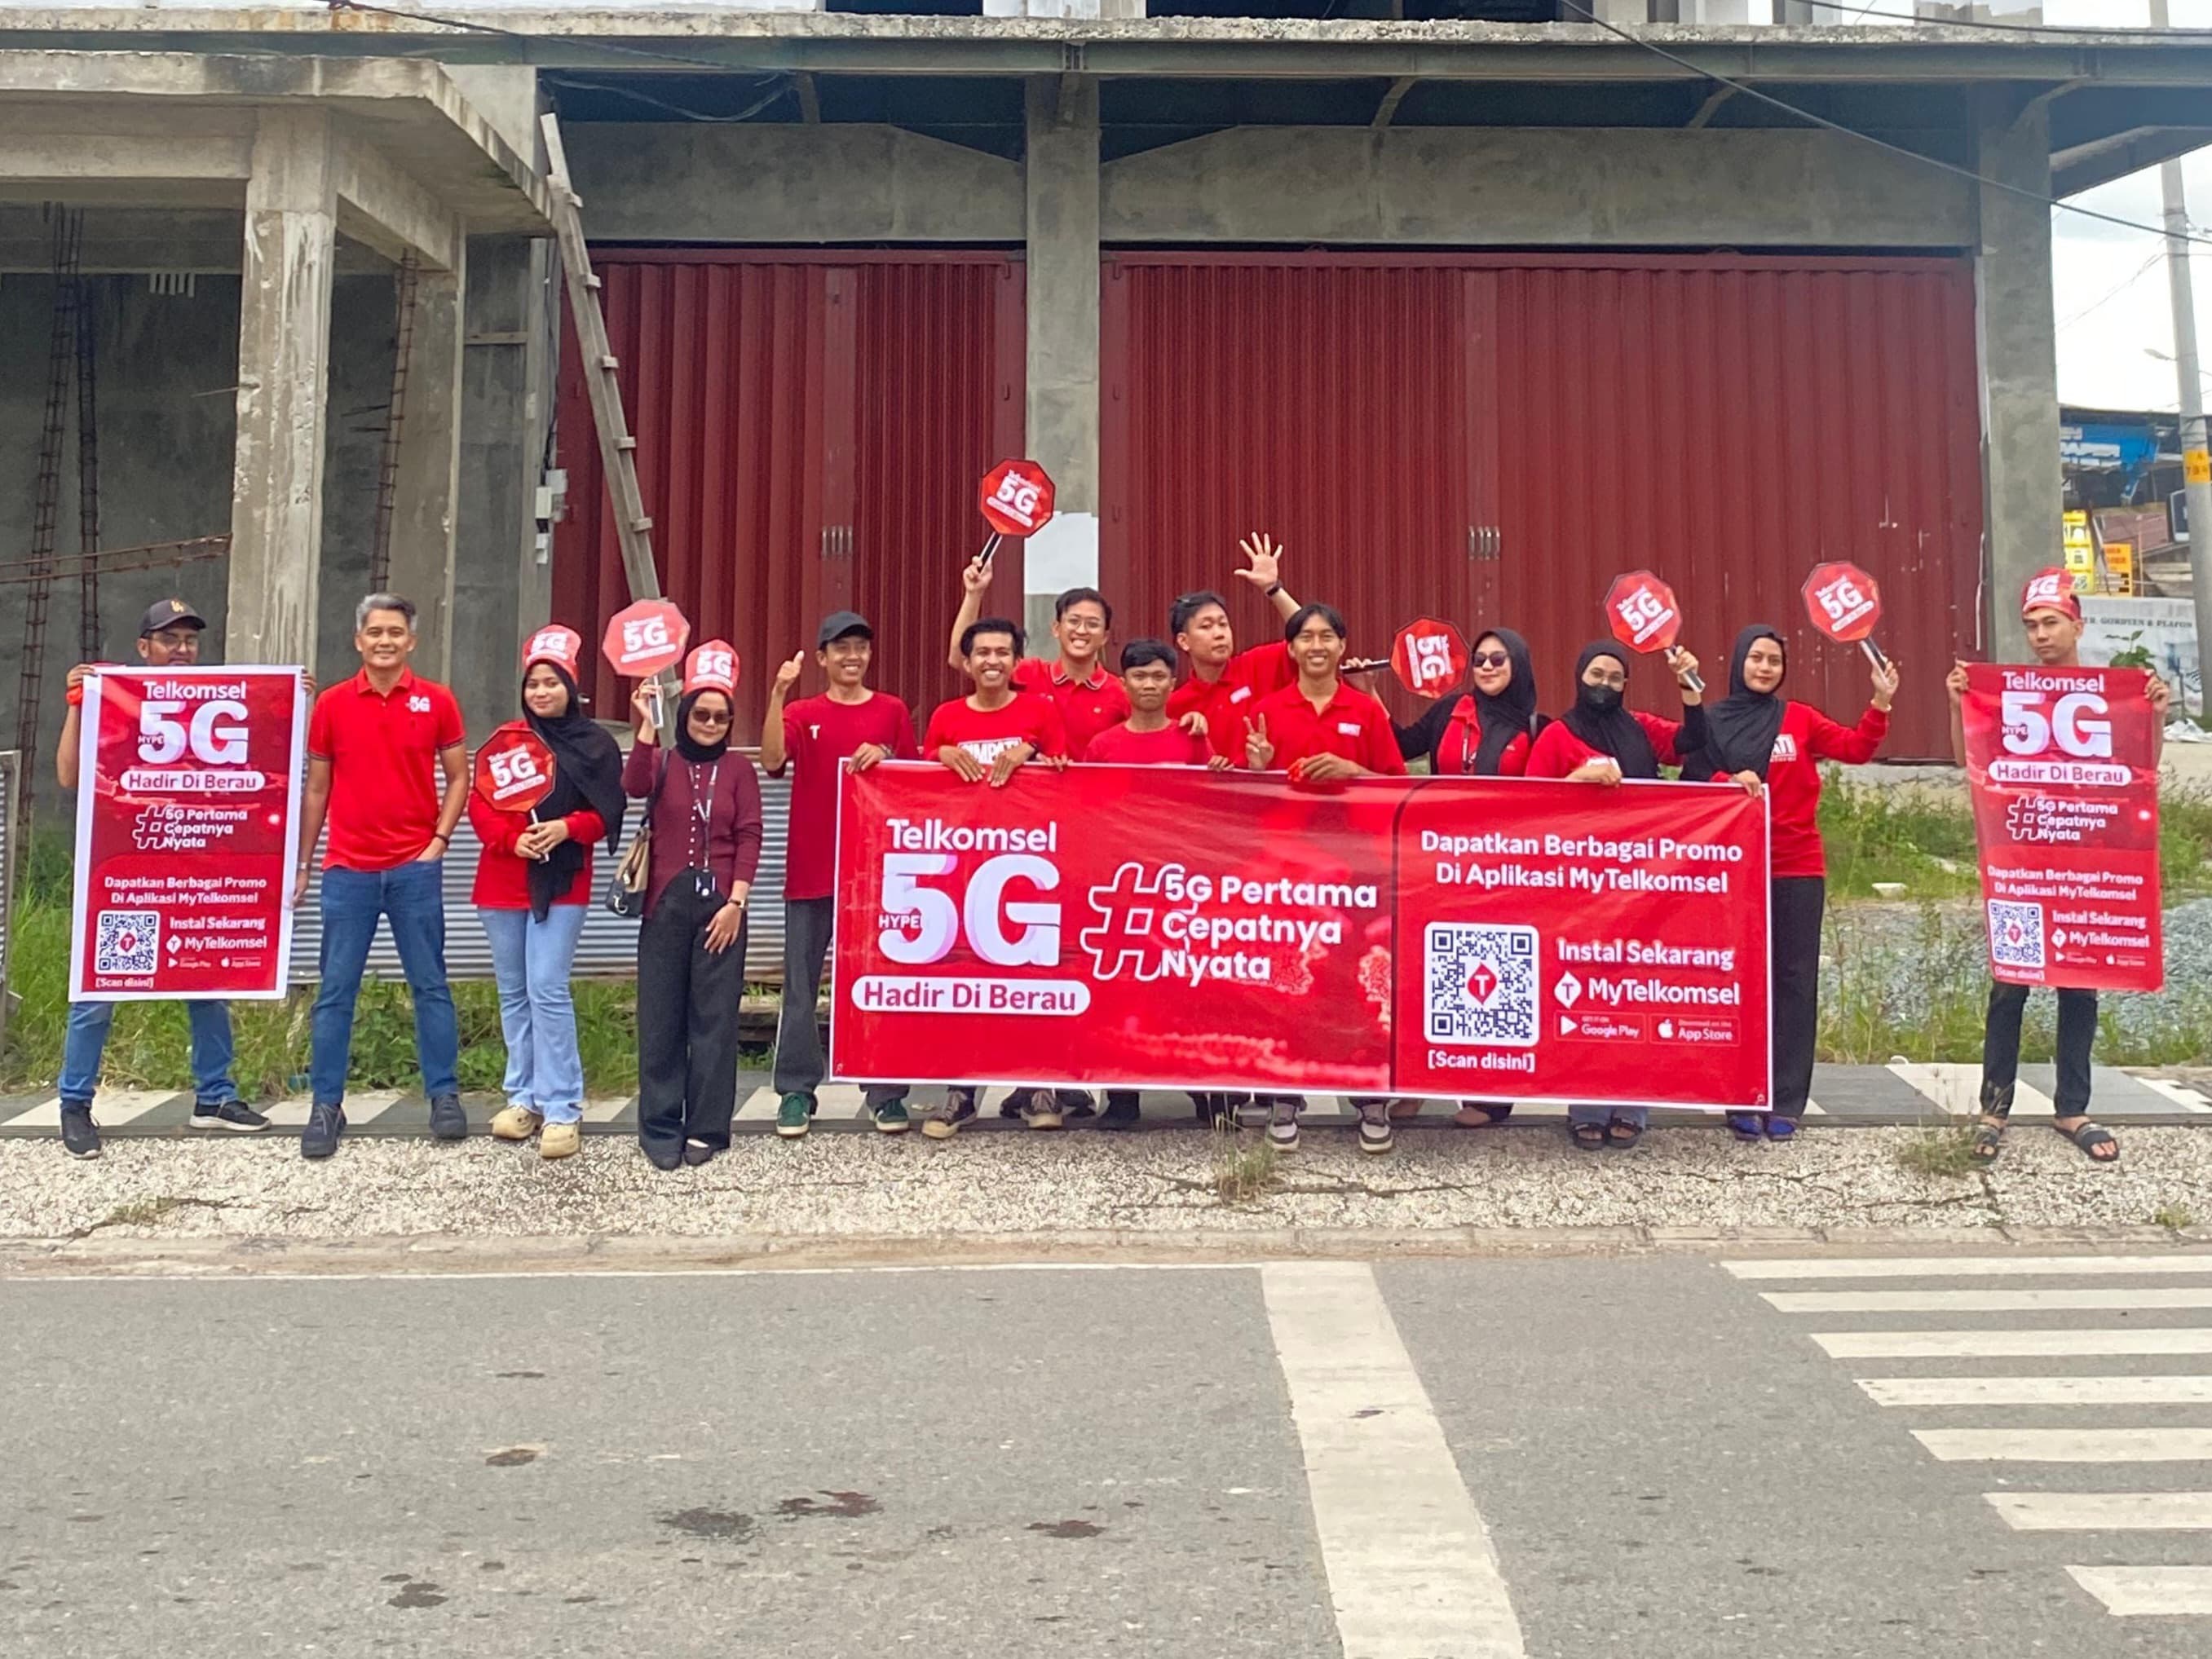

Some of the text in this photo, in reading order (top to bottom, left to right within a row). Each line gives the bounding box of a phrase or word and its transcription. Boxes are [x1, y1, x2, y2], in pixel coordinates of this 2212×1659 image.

[996, 476, 1038, 515] 5G
[1622, 592, 1663, 631] 5G
[1820, 582, 1863, 619] 5G
[623, 622, 667, 652] 5G
[696, 655, 731, 678] 5G
[1417, 636, 1446, 679] 5G
[143, 681, 246, 699] Telkomsel
[2002, 671, 2104, 693] Telkomsel
[409, 695, 430, 713] 5G
[138, 700, 249, 765] 5G
[2001, 691, 2113, 757] 5G
[490, 752, 536, 788] 5G
[1998, 765, 2124, 783] Hadir Di Berau
[129, 774, 256, 789] Hadir Di Berau
[187, 810, 248, 821] Pertama
[2058, 801, 2118, 815] Pertama
[164, 823, 233, 838] Cepatnya
[2038, 814, 2107, 830] Cepatnya
[164, 836, 205, 850] Nyata
[885, 818, 1057, 853] Telkomsel
[2038, 827, 2081, 842] Nyata
[1422, 831, 1742, 863] Dapatkan Berbagai Promo
[104, 877, 267, 892] Dapatkan Berbagai Promo
[1437, 863, 1728, 894] Di Aplikasi MyTelkomsel
[1987, 864, 2144, 887] Dapatkan Berbagai Promo
[112, 893, 258, 907] Di Aplikasi MyTelkomsel
[1165, 874, 1377, 909] 5G Pertama
[2008, 883, 2056, 898] Aplikasi
[2059, 885, 2136, 902] MyTelkomsel
[878, 854, 1061, 966] 5G
[2052, 910, 2146, 929] Instal Sekarang
[170, 916, 266, 930] Instal Sekarang
[878, 915, 922, 929] HYPE
[1163, 914, 1341, 952] Cepatnya
[184, 935, 267, 952] MyTelkomsel
[2069, 931, 2149, 948] MyTelkomsel
[1557, 940, 1734, 971] Instal Sekarang
[1163, 951, 1270, 986] Nyata
[864, 982, 1075, 1012] Hadir Di Berau
[1589, 979, 1739, 1006] MyTelkomsel
[1582, 1024, 1639, 1039] Google Play
[1678, 1028, 1733, 1041] App Store
[1428, 1048, 1534, 1073] [Scan disini]
